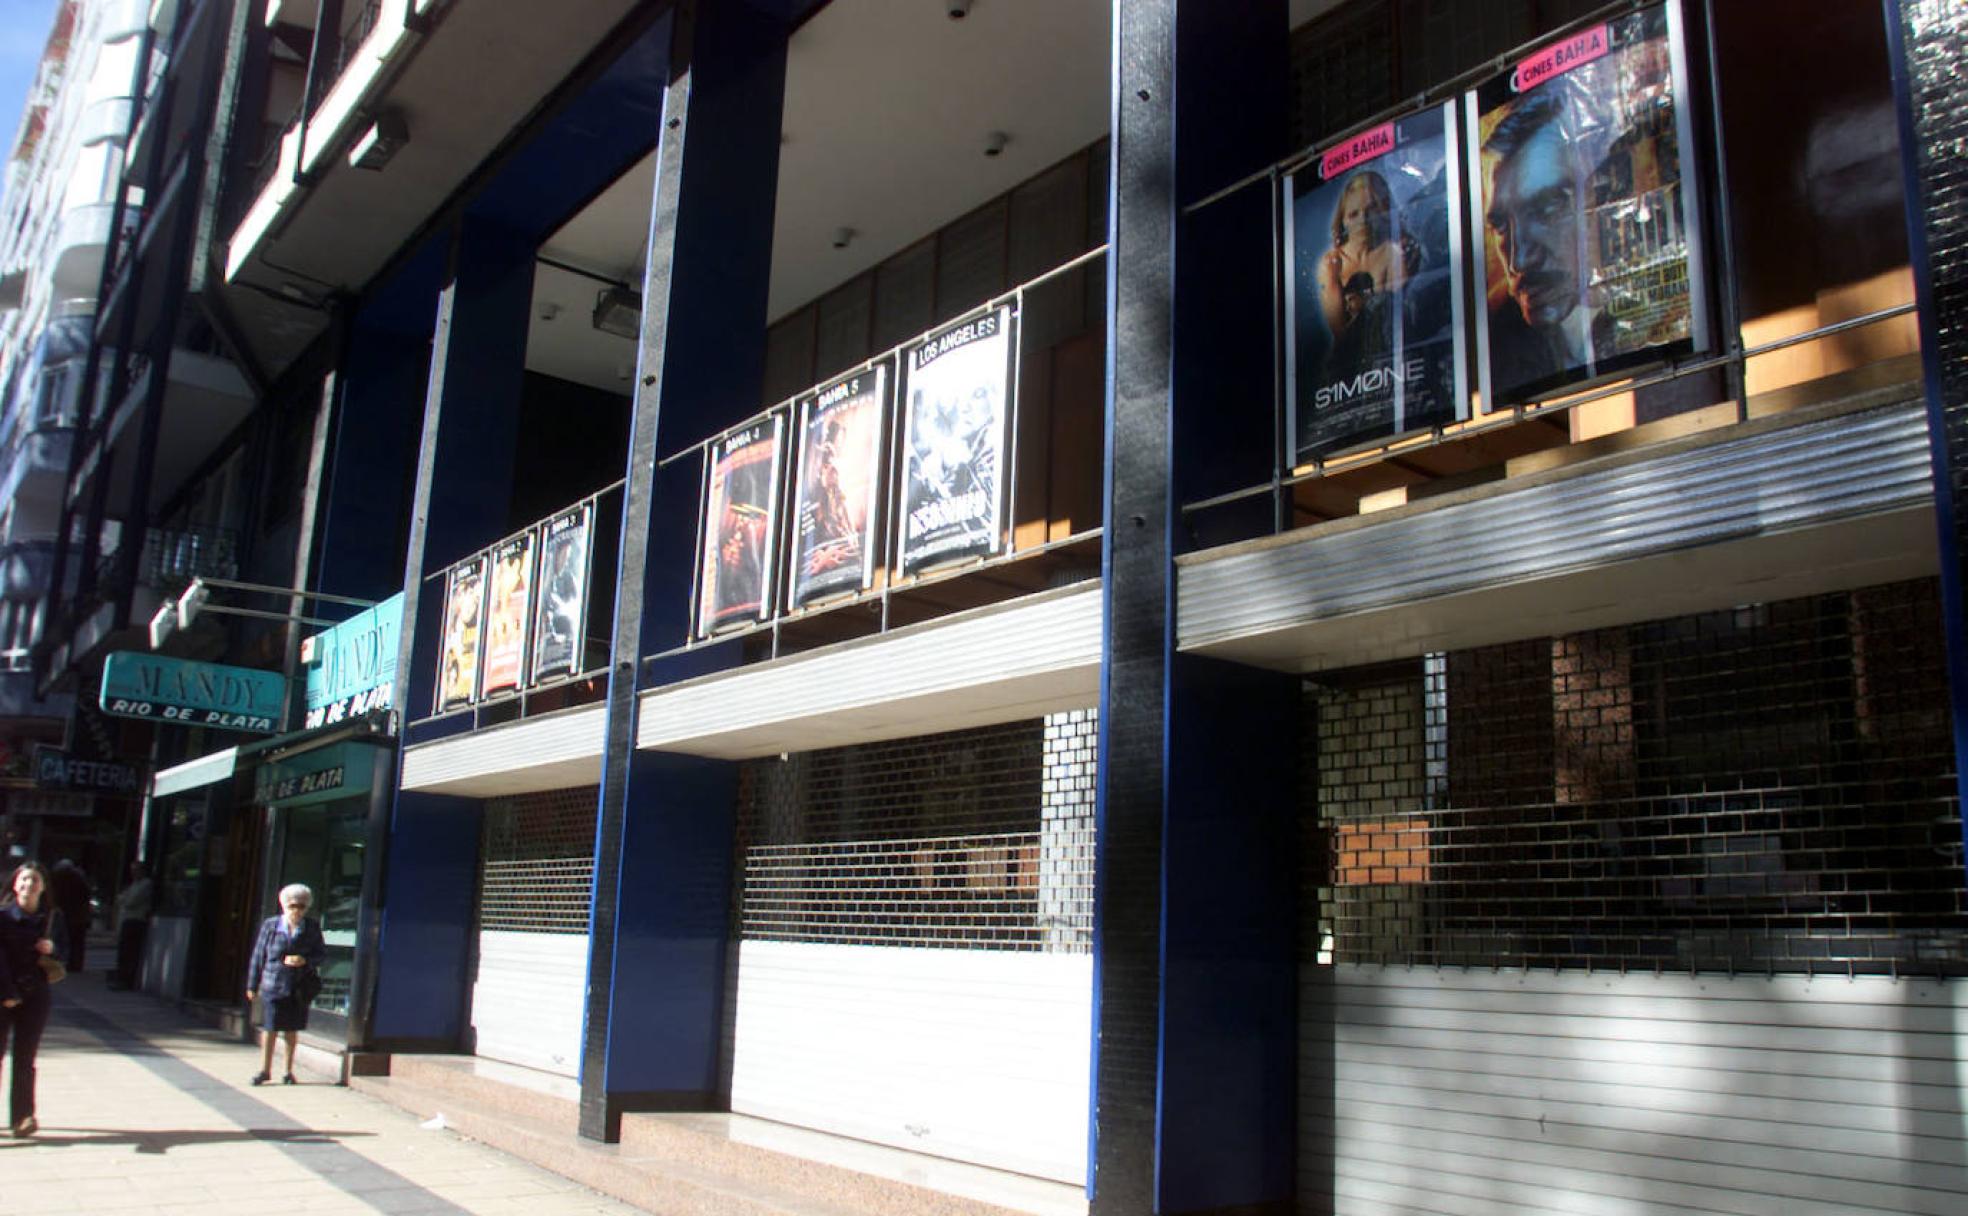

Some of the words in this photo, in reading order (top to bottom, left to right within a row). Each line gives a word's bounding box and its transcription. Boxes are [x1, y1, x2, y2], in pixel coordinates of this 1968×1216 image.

[1522, 59, 1553, 82] CINES
[1327, 153, 1350, 172] CINES
[1352, 131, 1389, 158] BAHIA
[919, 341, 939, 366] LOS
[939, 317, 996, 352] ANGELES
[134, 663, 264, 710] MANDY
[112, 699, 152, 715] RIO
[163, 705, 195, 721] DE
[205, 711, 272, 730] PLATA
[40, 756, 137, 793] CAFETERIA
[301, 767, 343, 793] PLATA
